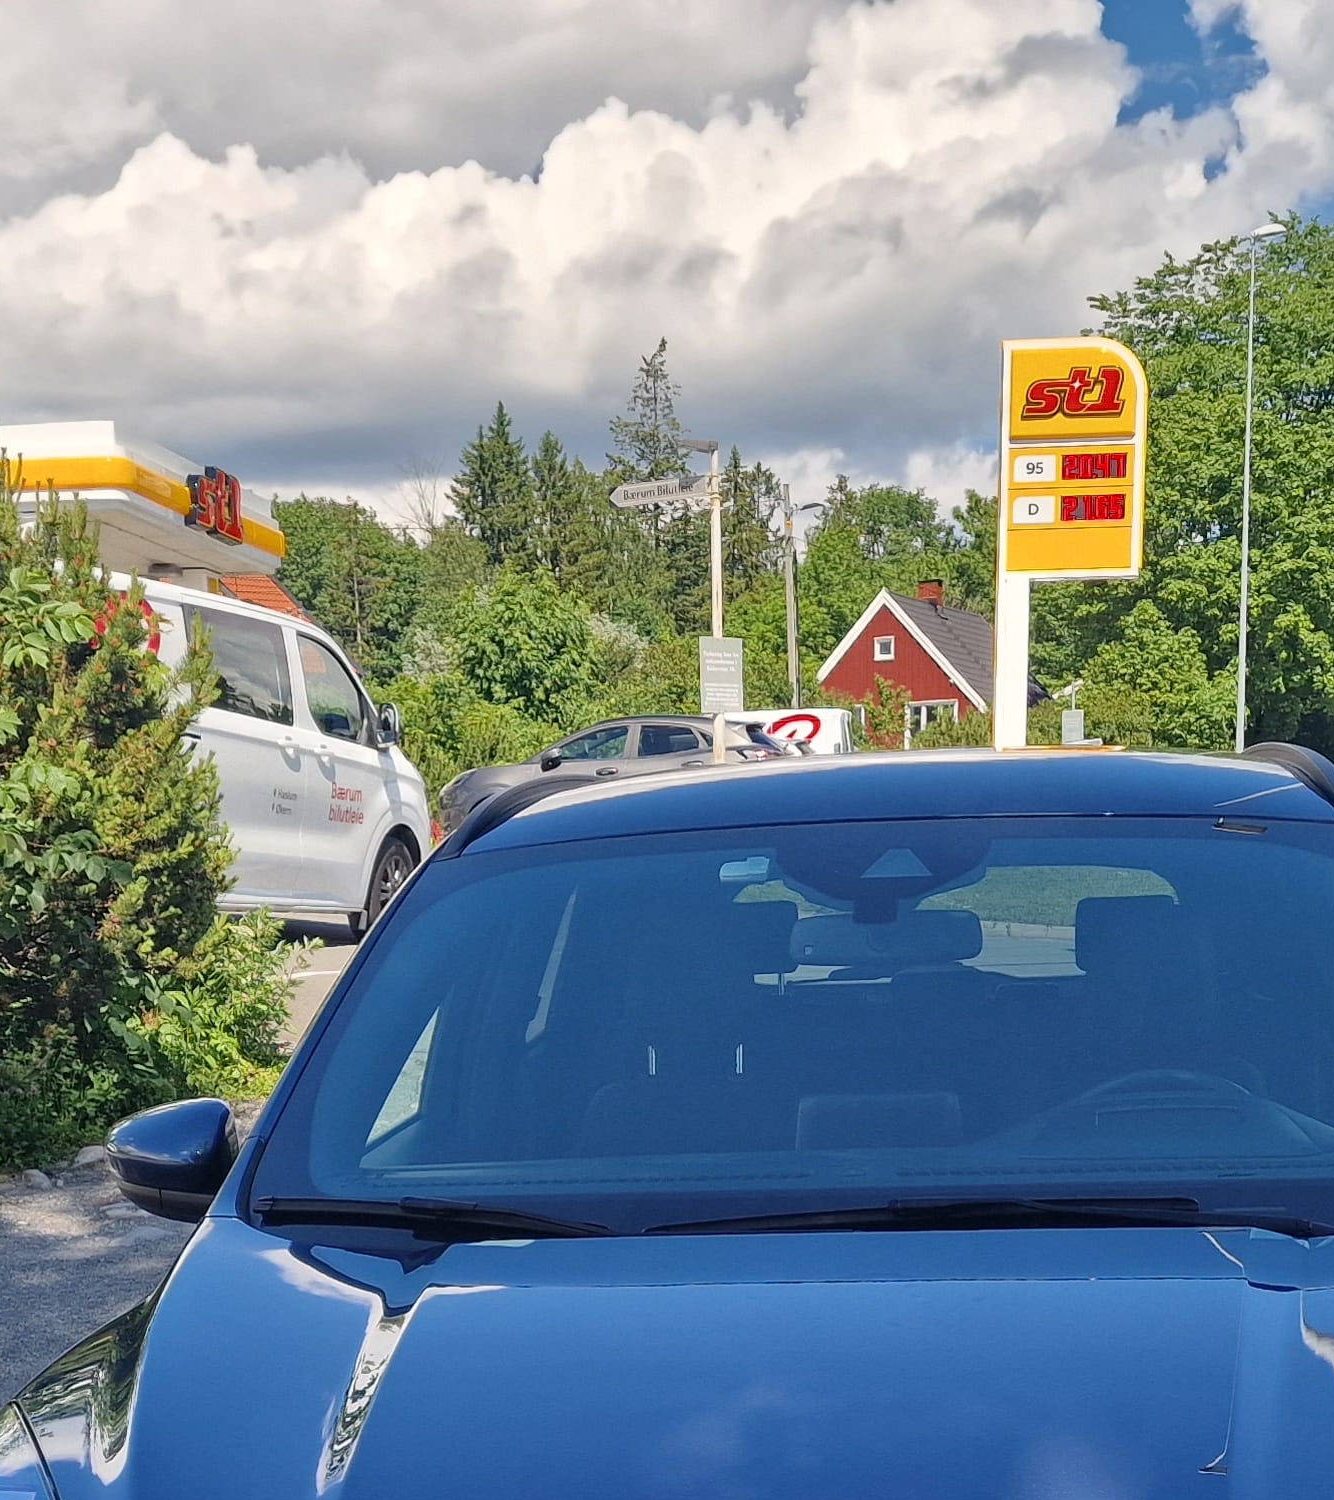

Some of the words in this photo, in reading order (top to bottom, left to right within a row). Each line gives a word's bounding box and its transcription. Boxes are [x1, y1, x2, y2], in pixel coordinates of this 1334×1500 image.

[1021, 366, 1125, 421] st1
[1026, 462, 1044, 475] 95
[623, 489, 656, 501] Bærum
[657, 482, 694, 497] Bilutleie
[1028, 503, 1040, 516] D
[331, 782, 362, 803] Bærum
[328, 803, 364, 825] bilutleie
